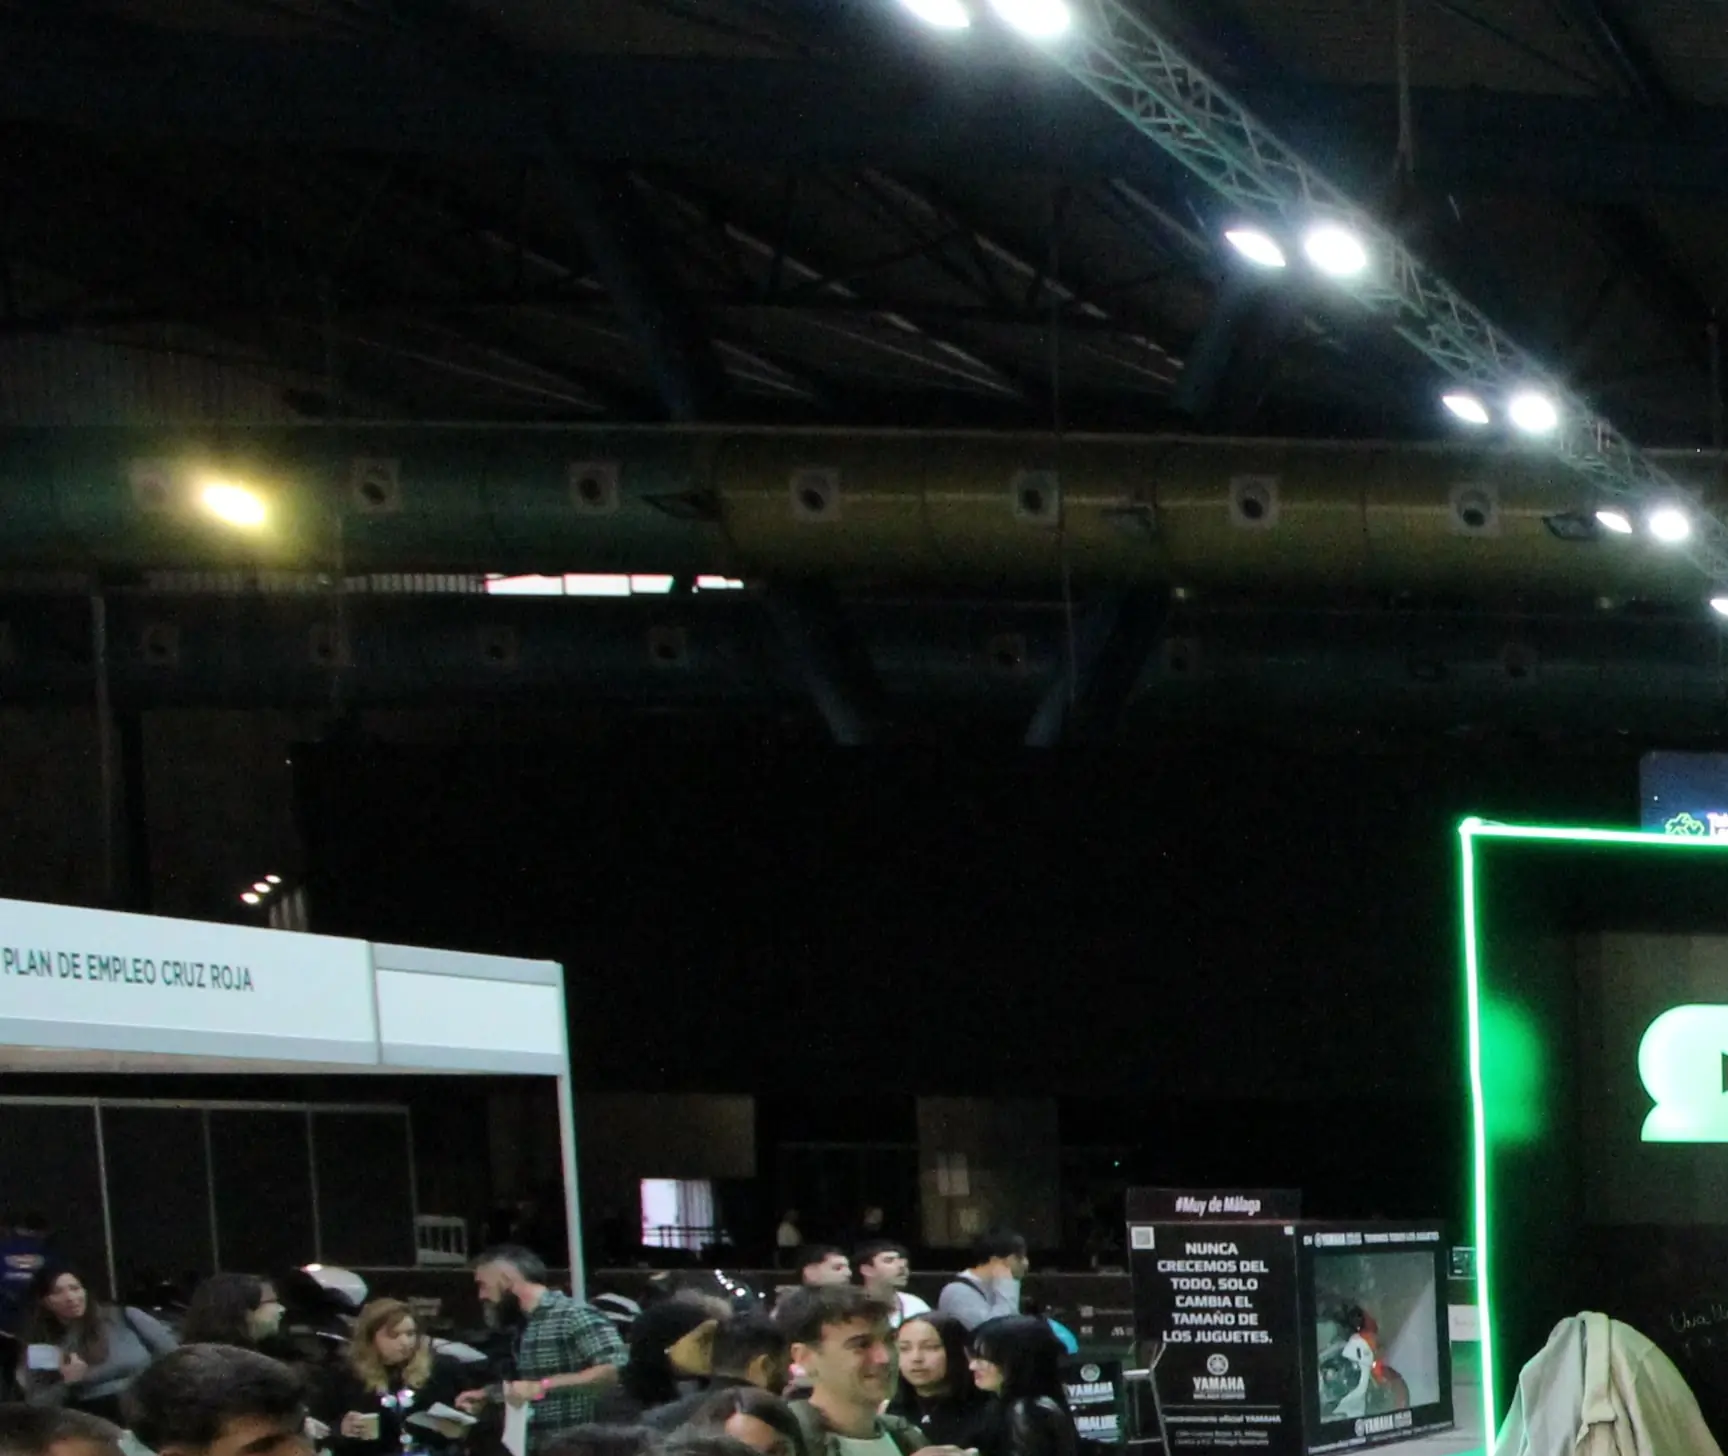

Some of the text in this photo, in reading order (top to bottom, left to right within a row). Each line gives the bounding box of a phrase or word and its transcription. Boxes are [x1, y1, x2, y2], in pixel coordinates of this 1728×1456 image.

[2, 947, 255, 992] PLAN DE EMPLEO CRUZ ROJA
[1175, 1195, 1261, 1217] #Muy de Málaga
[1184, 1242, 1239, 1256] NUNCA
[1157, 1260, 1269, 1273] CRECEMOS DEL
[1170, 1277, 1259, 1292] TODO, SOLO
[1175, 1295, 1253, 1309] CAMBIA EL
[1172, 1310, 1259, 1326] TAMAÑO DE
[1162, 1330, 1274, 1345] LOS JUGUETES.
[1191, 1376, 1245, 1391] YAMAHA
